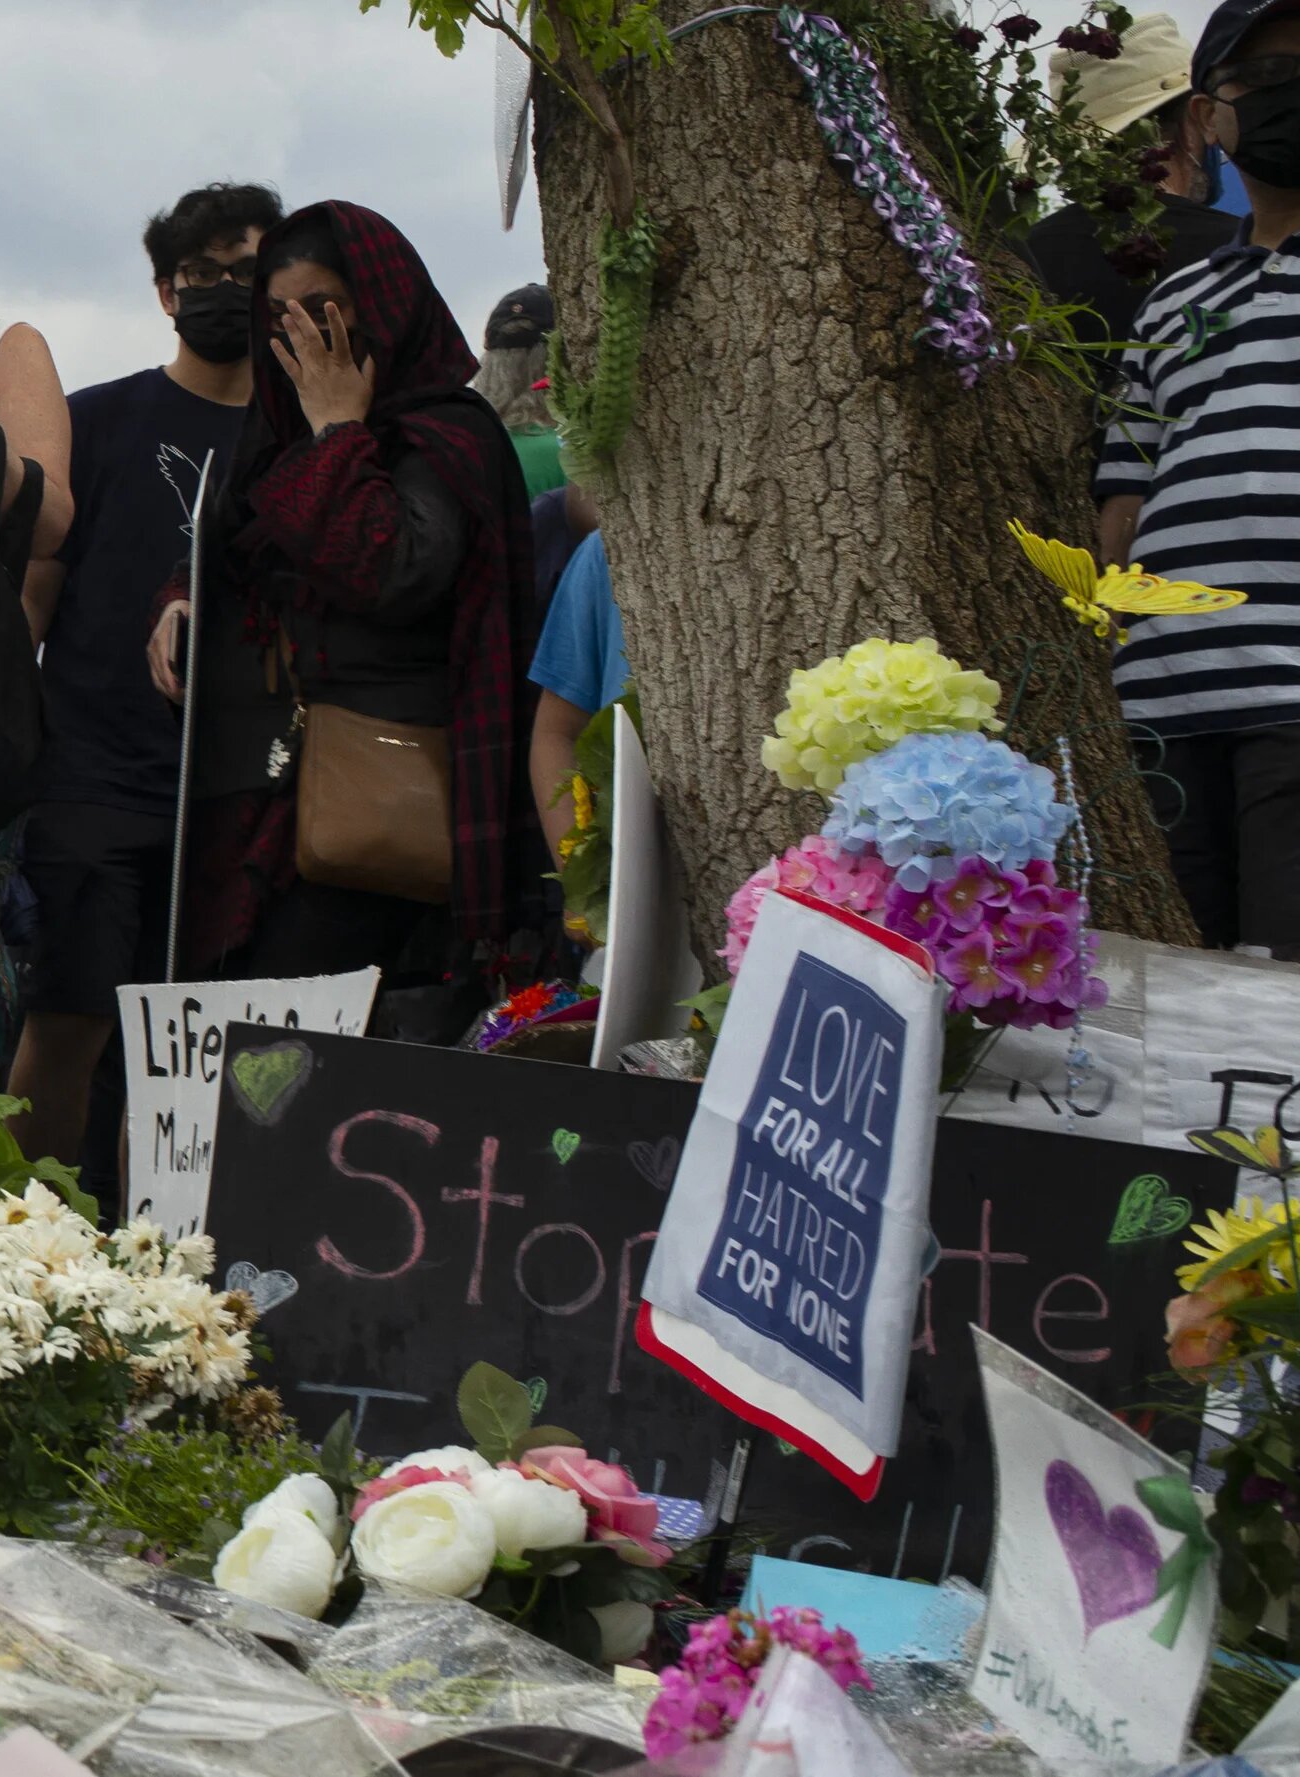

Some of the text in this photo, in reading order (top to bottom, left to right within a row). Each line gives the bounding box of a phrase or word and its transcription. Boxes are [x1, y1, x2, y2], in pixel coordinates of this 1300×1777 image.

[779, 988, 895, 1147] LOVE
[753, 1096, 869, 1215] FOR ALL
[716, 1237, 780, 1310] FOR
[733, 1162, 866, 1301] HATRED
